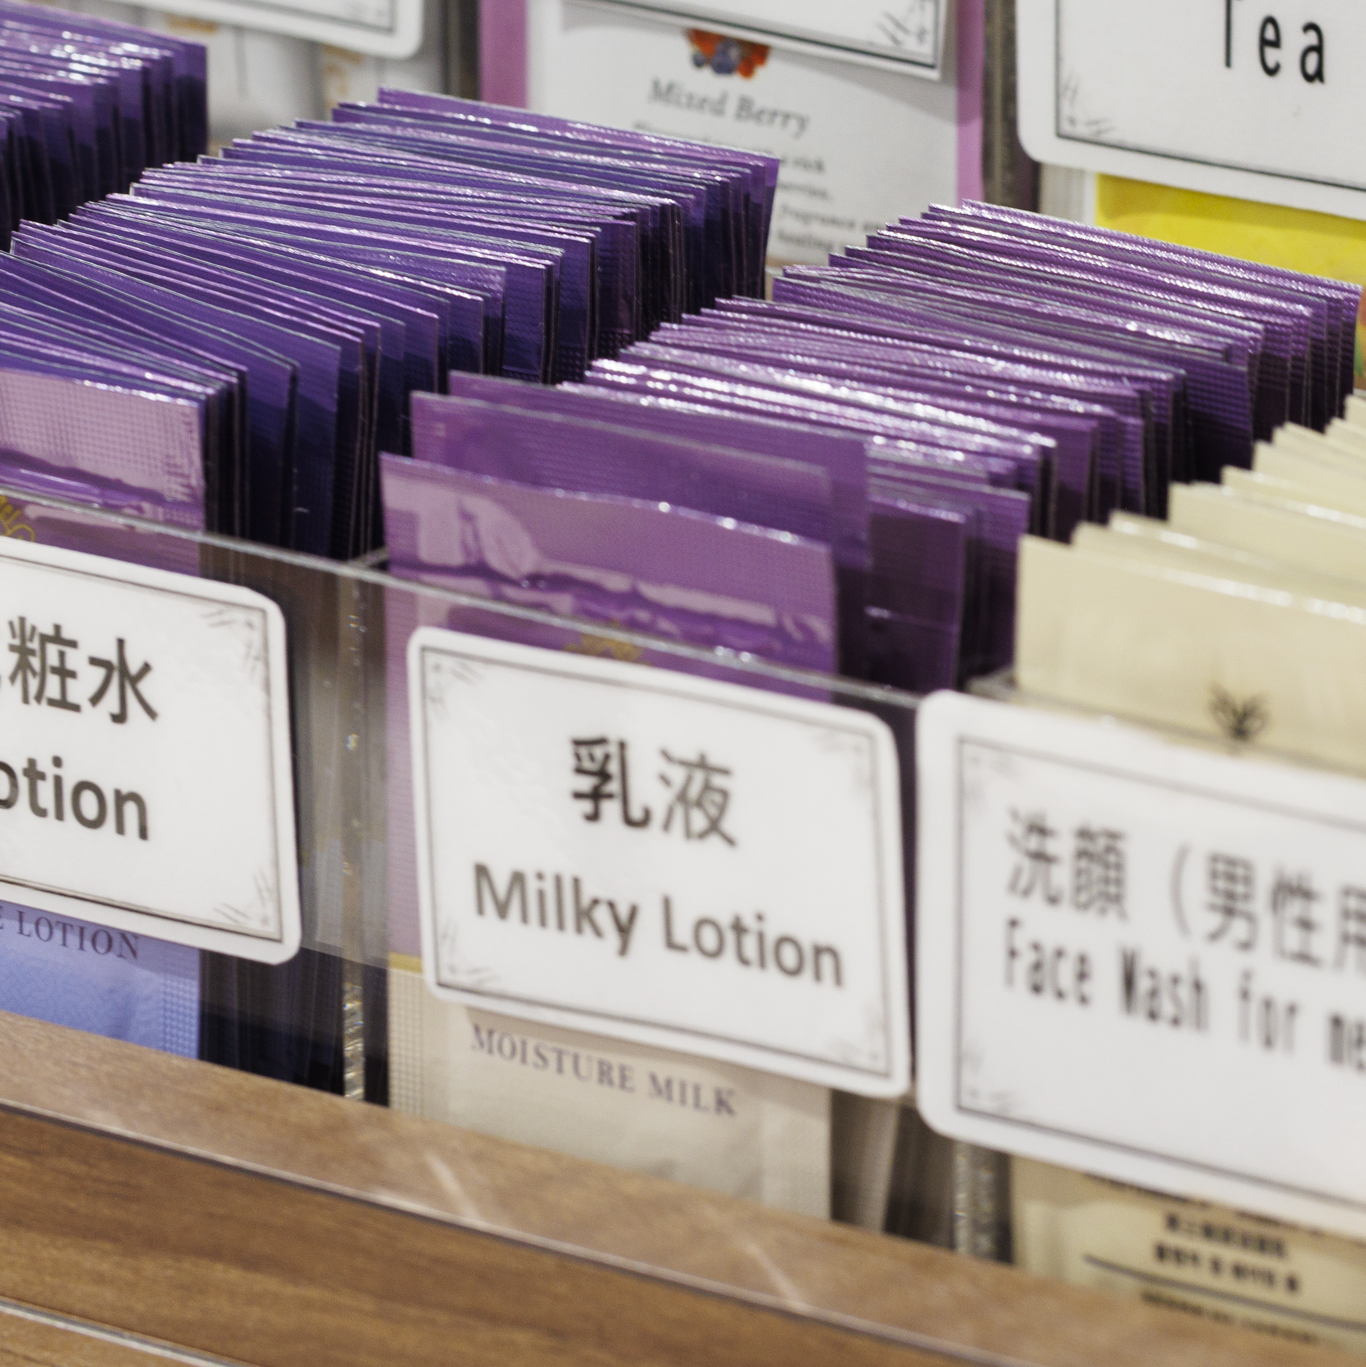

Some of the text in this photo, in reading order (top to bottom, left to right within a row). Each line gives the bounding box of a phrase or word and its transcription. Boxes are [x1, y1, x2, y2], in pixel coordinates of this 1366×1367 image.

[649, 79, 811, 140] Mixed Berry
[570, 735, 738, 848] 乳液
[17, 914, 139, 961] LOTION
[473, 862, 844, 989] Milky Lotion
[1005, 918, 1092, 1007] Face
[1121, 943, 1210, 1036] Wash
[1237, 970, 1301, 1054] for
[470, 1024, 738, 1117] MOISTURE MILK
